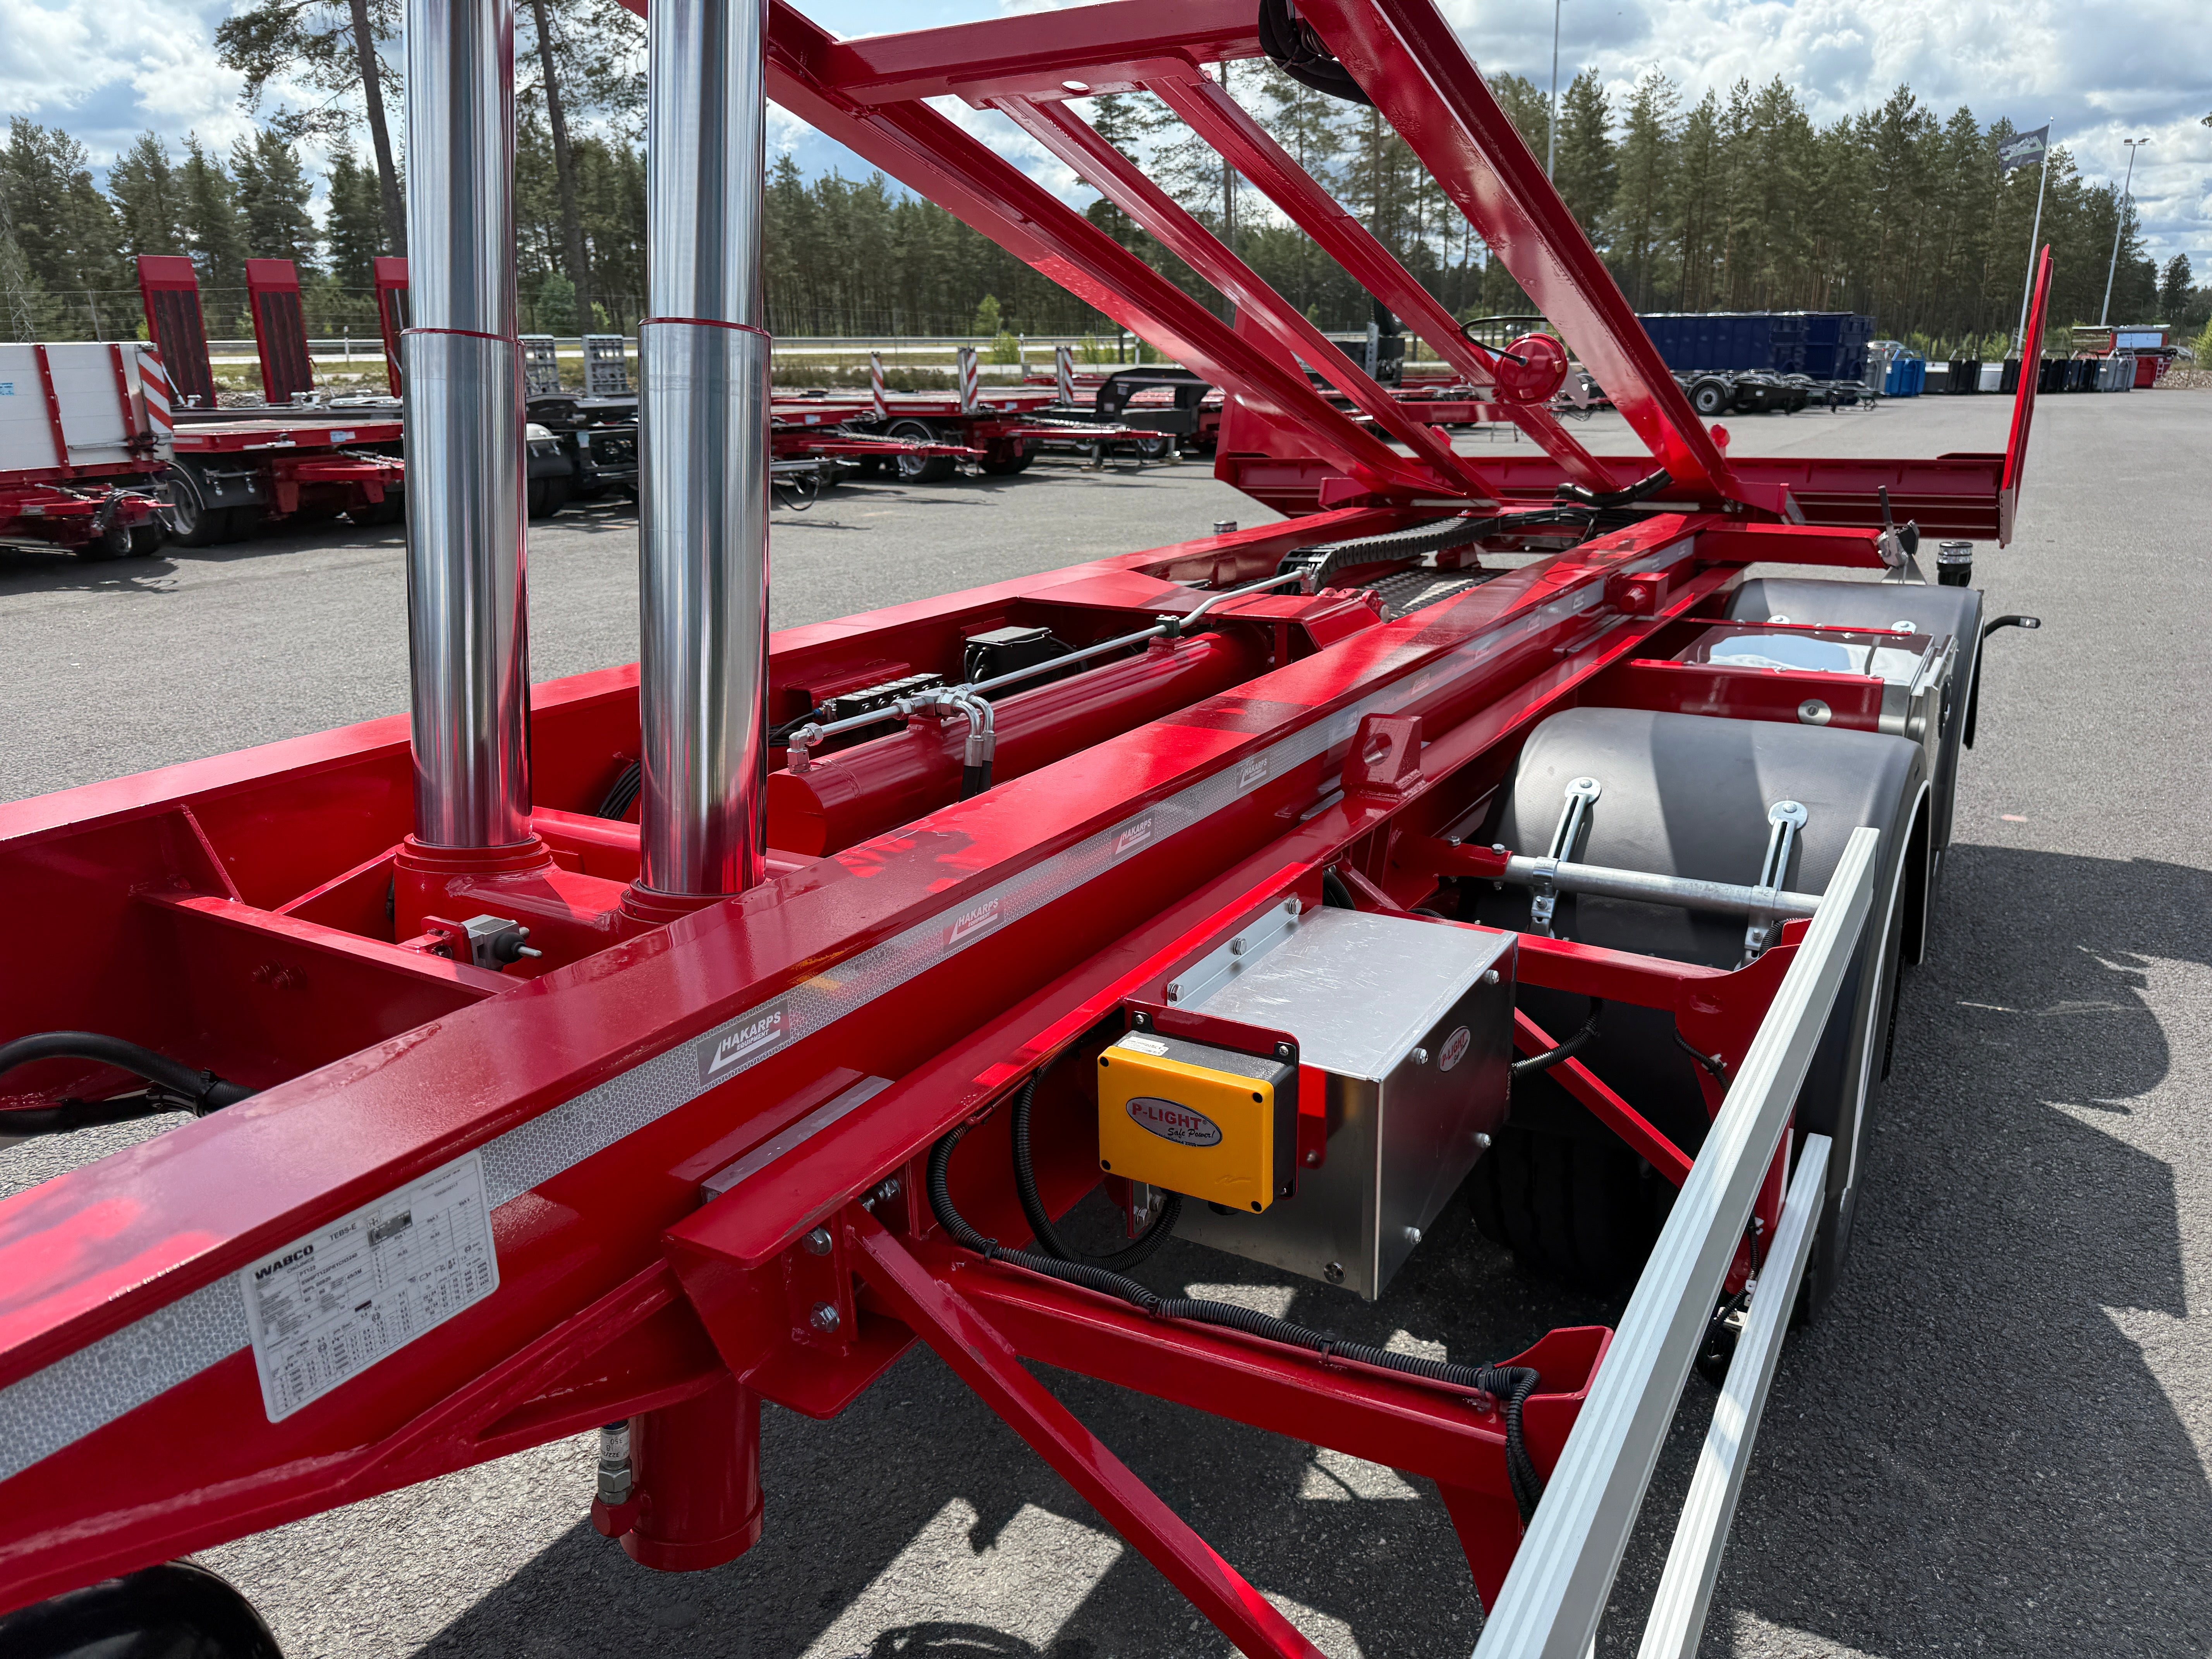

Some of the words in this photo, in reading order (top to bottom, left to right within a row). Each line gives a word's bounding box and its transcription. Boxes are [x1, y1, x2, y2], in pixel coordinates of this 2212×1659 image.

[1122, 818, 1152, 841] HAKARPS
[958, 898, 998, 927] HAKARPS
[721, 1011, 781, 1052] HAKARPS
[737, 1029, 769, 1051] EQUIPMENT
[1132, 1103, 1202, 1130] P-LIGHT
[1167, 1127, 1185, 1139] Safe
[1188, 1128, 1215, 1138] Power!
[255, 1244, 314, 1280] WABCO
[330, 1223, 357, 1241] TEBS-E
